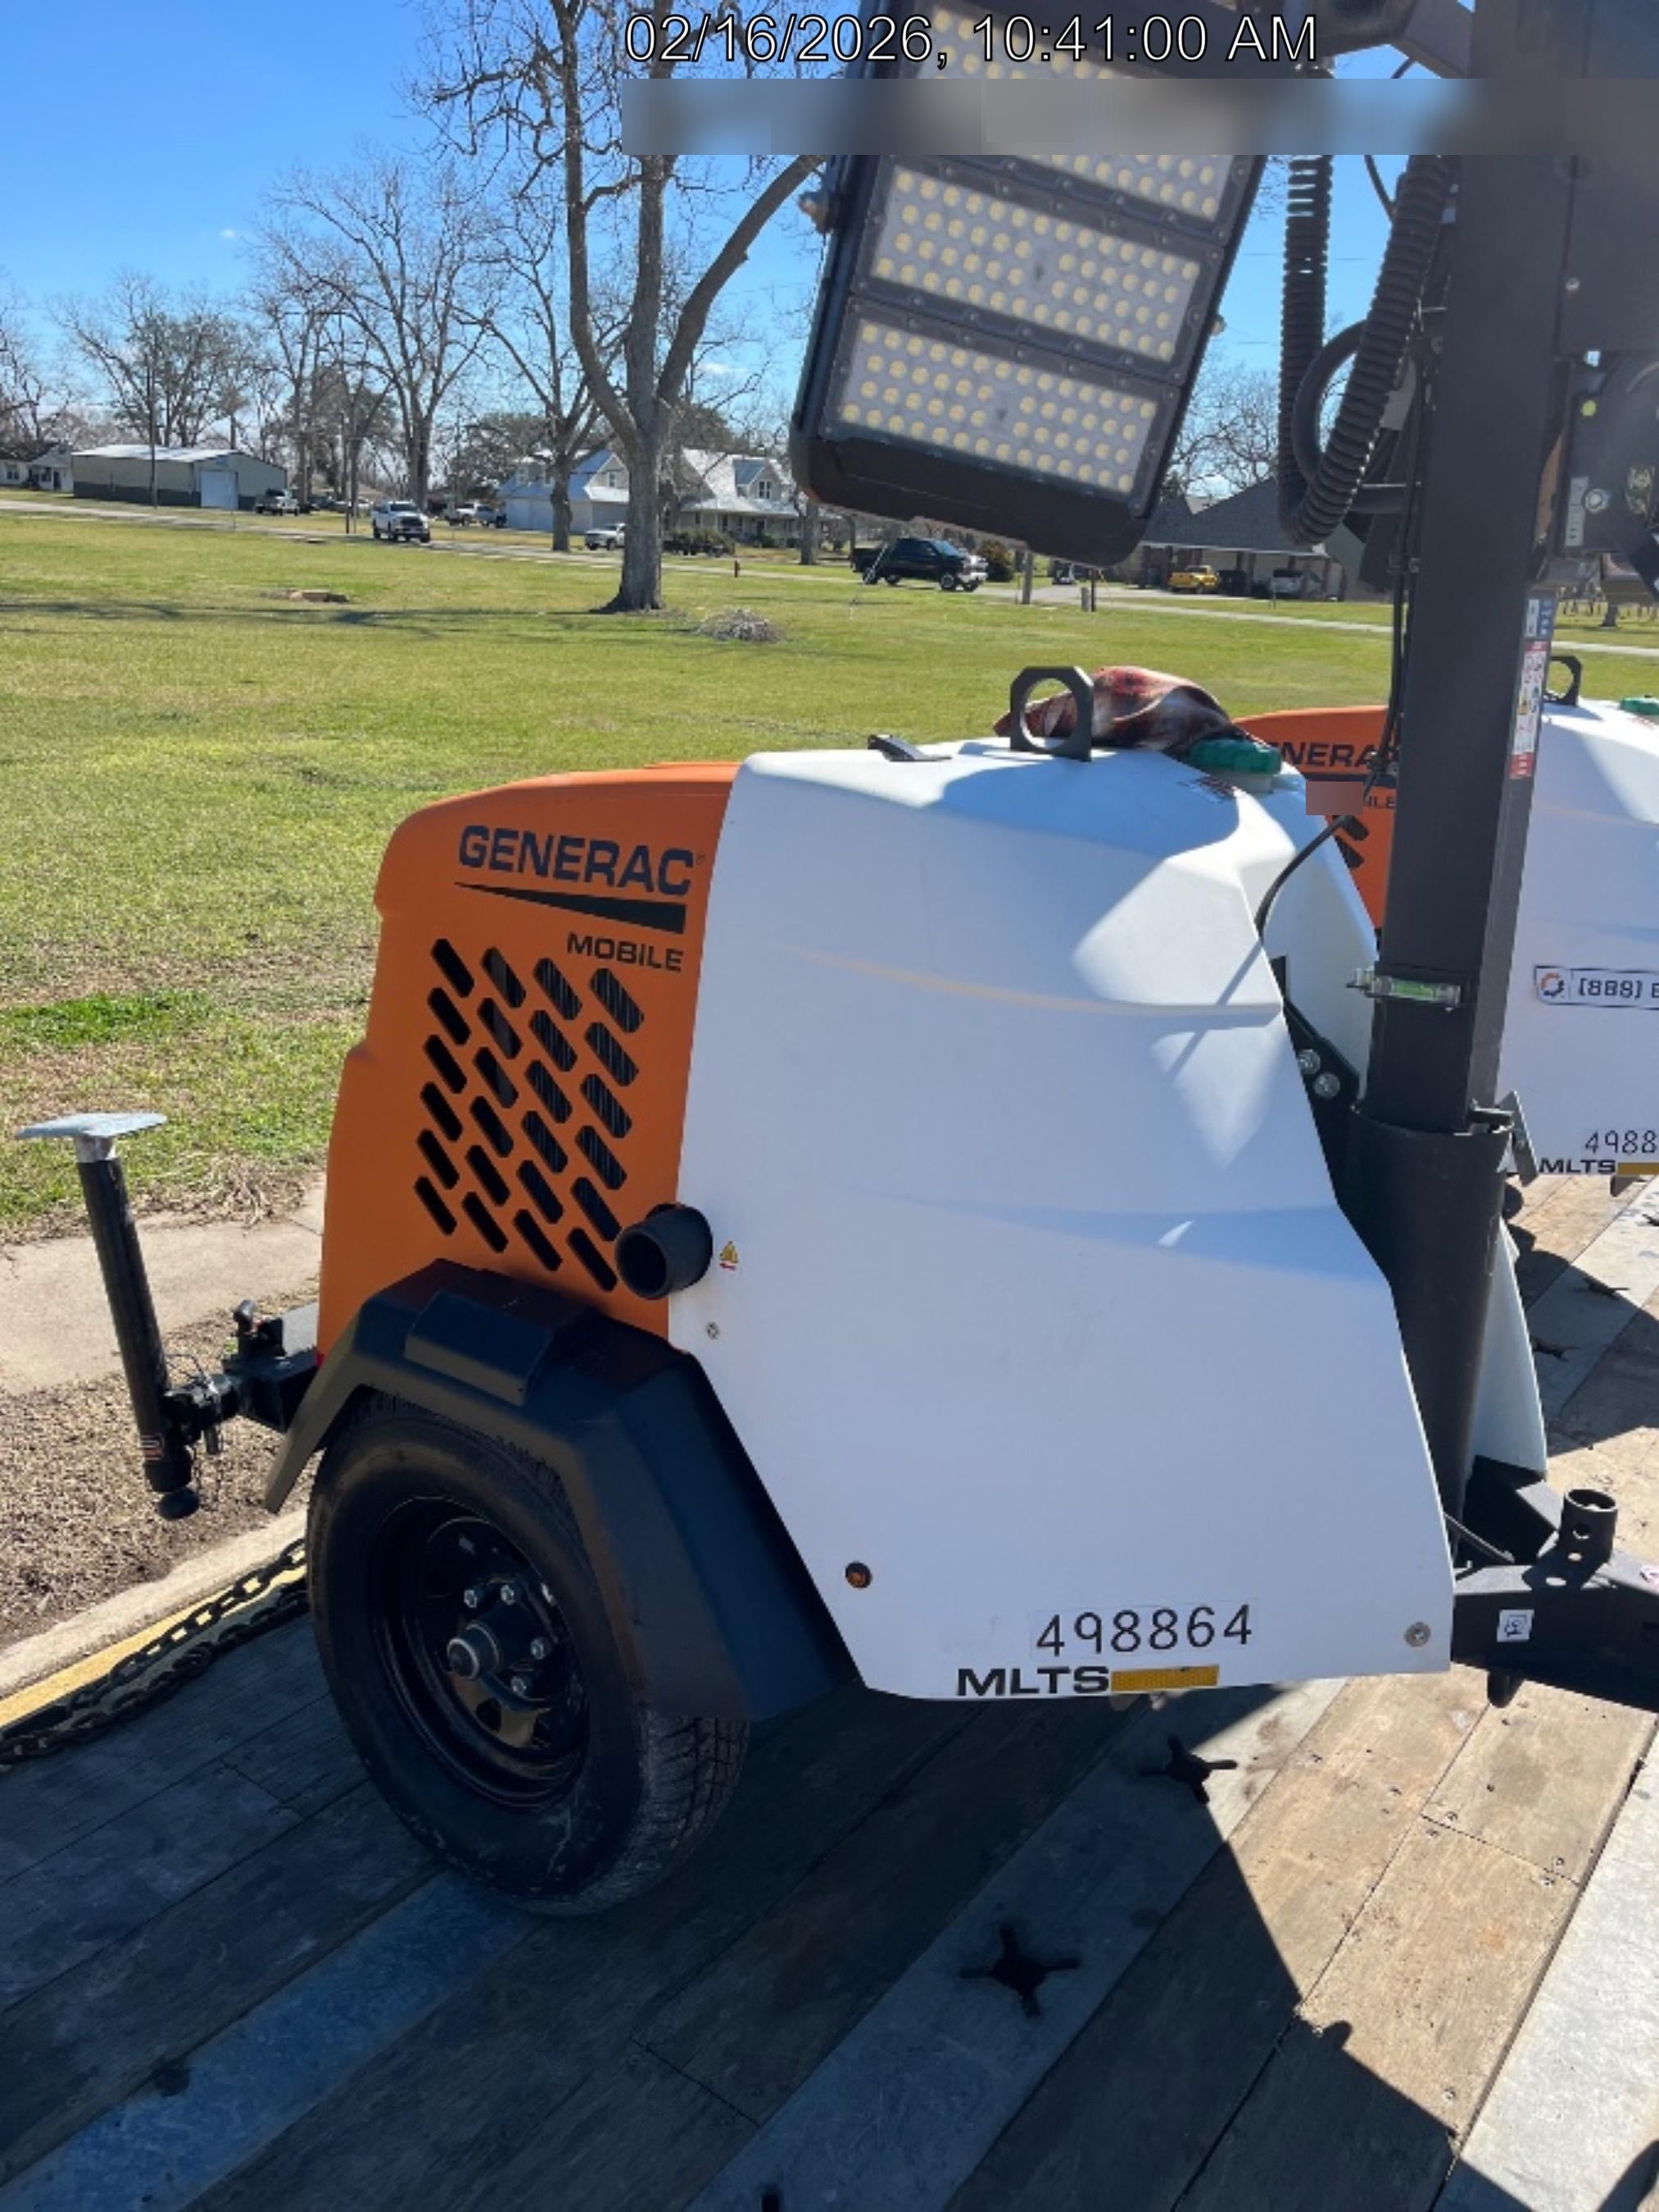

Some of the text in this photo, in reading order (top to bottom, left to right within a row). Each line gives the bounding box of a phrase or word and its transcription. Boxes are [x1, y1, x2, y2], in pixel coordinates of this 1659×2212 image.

[1268, 741, 1386, 768] NERA
[459, 824, 695, 895] GENERAC
[567, 932, 684, 972] MOBILE
[1539, 1157, 1616, 1173] MLTS
[1036, 1604, 1252, 1657] 498864
[957, 1666, 1109, 1696] MLTS
